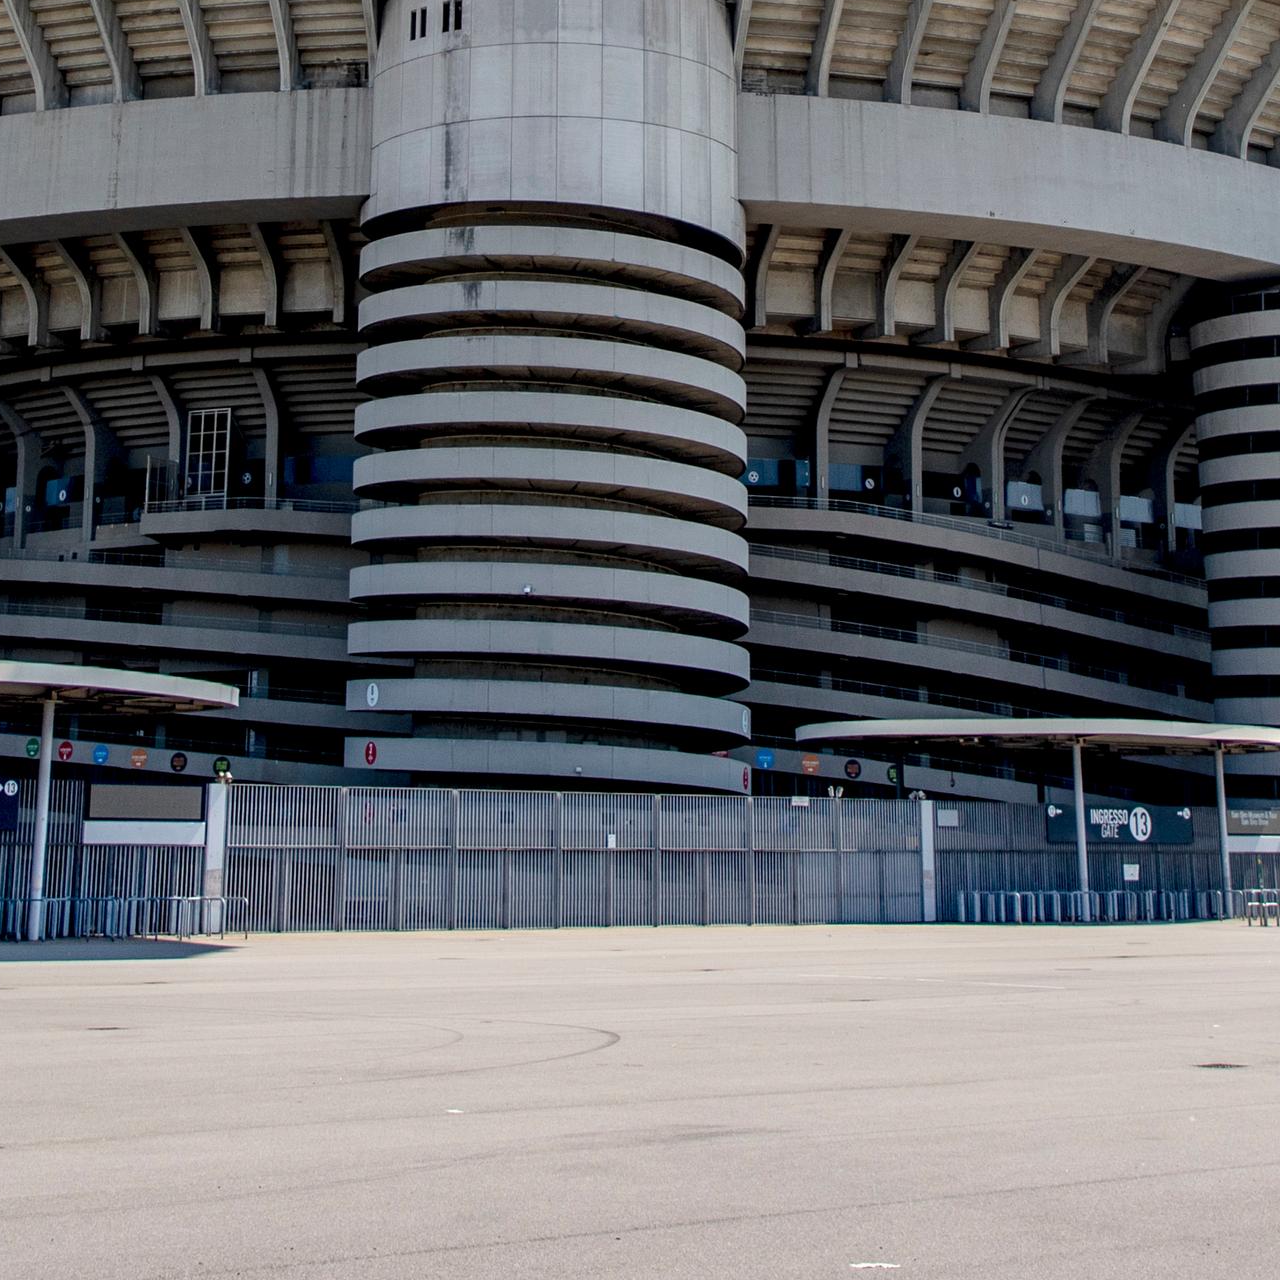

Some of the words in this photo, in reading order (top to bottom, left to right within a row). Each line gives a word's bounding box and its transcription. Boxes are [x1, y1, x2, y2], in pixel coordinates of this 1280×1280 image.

[7, 782, 17, 794] 13
[1090, 808, 1129, 825] INGRESSO
[1133, 812, 1148, 837] 13
[1101, 823, 1120, 839] GATE
